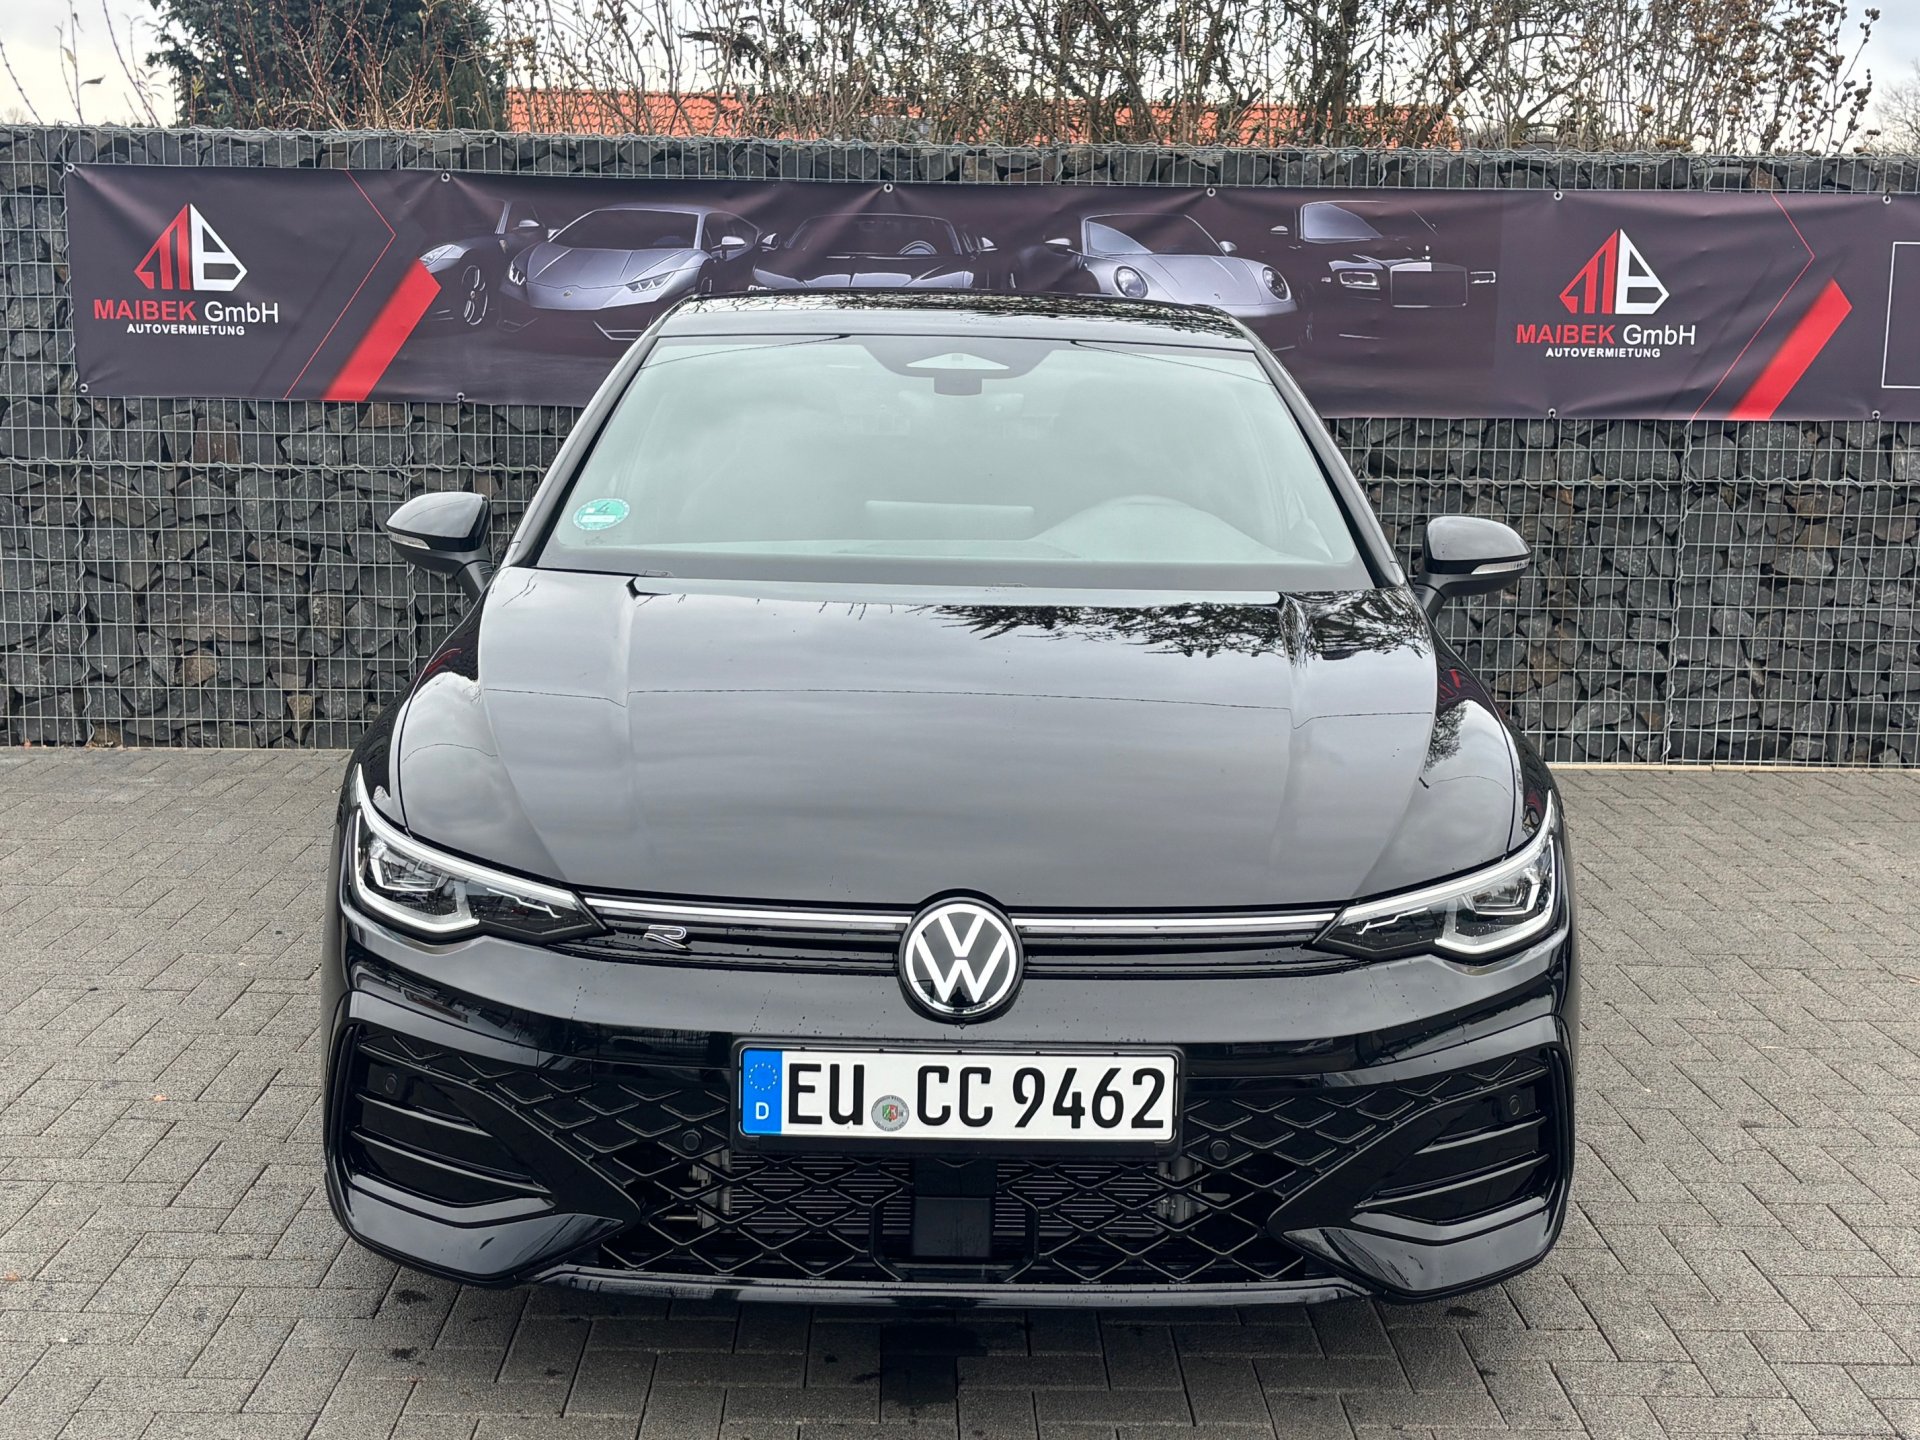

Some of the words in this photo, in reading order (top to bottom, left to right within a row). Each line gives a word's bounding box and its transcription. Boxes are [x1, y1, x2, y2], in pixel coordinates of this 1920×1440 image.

[93, 299, 197, 321] MAIBEK
[204, 301, 278, 325] GmbH
[126, 323, 246, 336] AUTOVERMIETUNG
[1516, 324, 1615, 344] MAIBEK
[1622, 324, 1696, 346] GmbH
[1545, 347, 1661, 359] AUTOVERMIETUNG
[912, 909, 1010, 1005] VW
[787, 1063, 865, 1125] EU
[917, 1065, 993, 1127] CC
[1012, 1067, 1166, 1129] 9462
[755, 1102, 770, 1120] D
